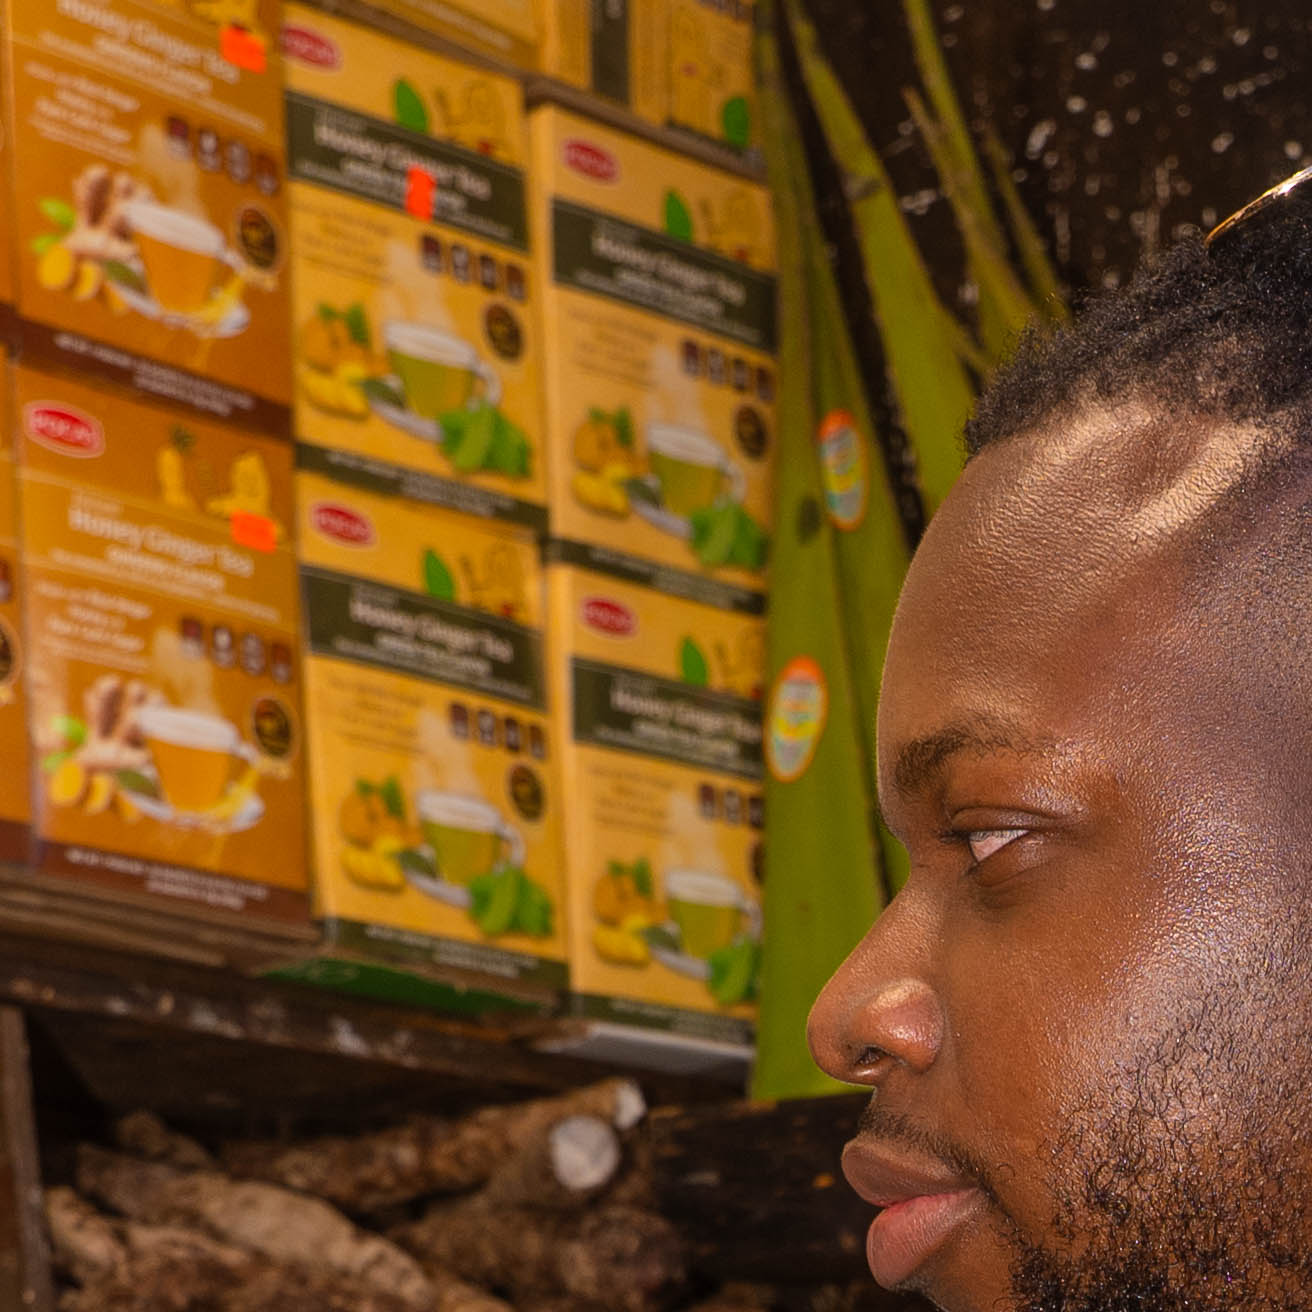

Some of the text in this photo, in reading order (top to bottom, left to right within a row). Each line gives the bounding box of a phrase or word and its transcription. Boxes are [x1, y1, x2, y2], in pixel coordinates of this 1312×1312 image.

[68, 508, 254, 578] Honey Ginger Tea
